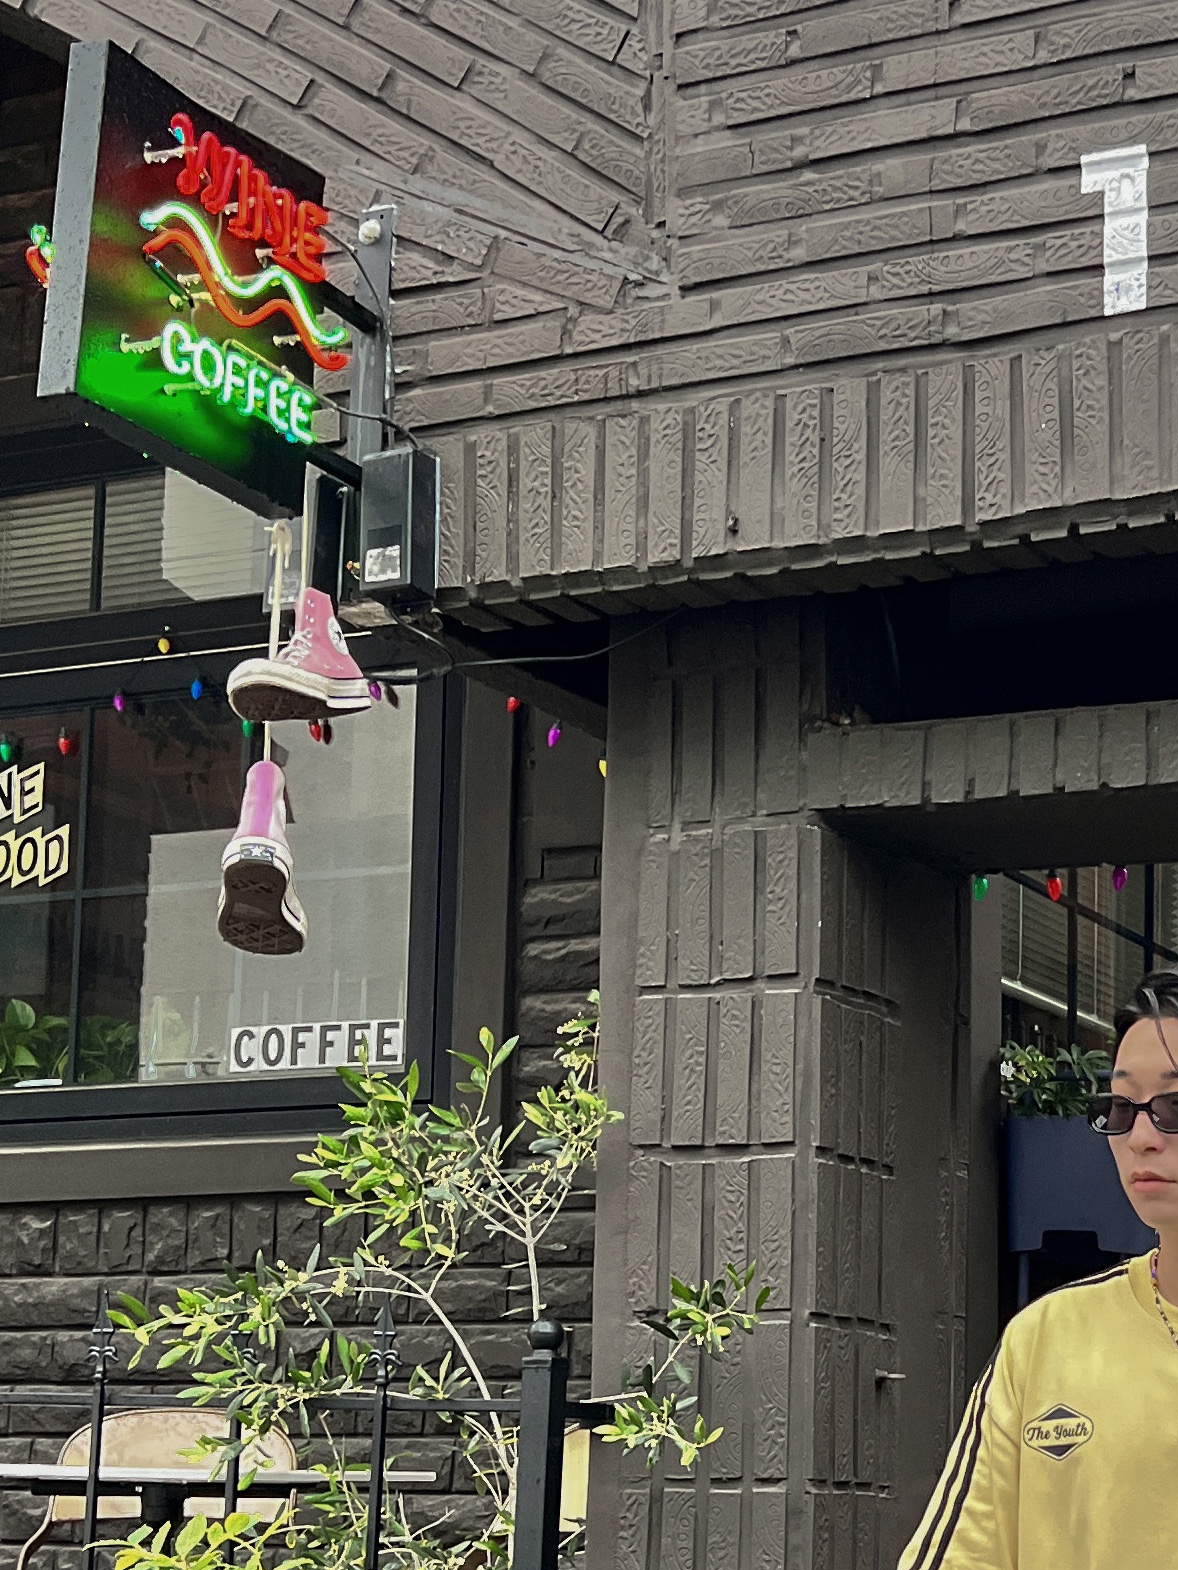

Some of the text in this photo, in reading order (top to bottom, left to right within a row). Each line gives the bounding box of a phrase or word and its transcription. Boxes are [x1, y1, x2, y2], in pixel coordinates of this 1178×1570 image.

[170, 112, 330, 284] WINE
[160, 319, 317, 446] COFFEE
[233, 1020, 401, 1069] COFFEE
[1026, 1421, 1090, 1441] The Youth
